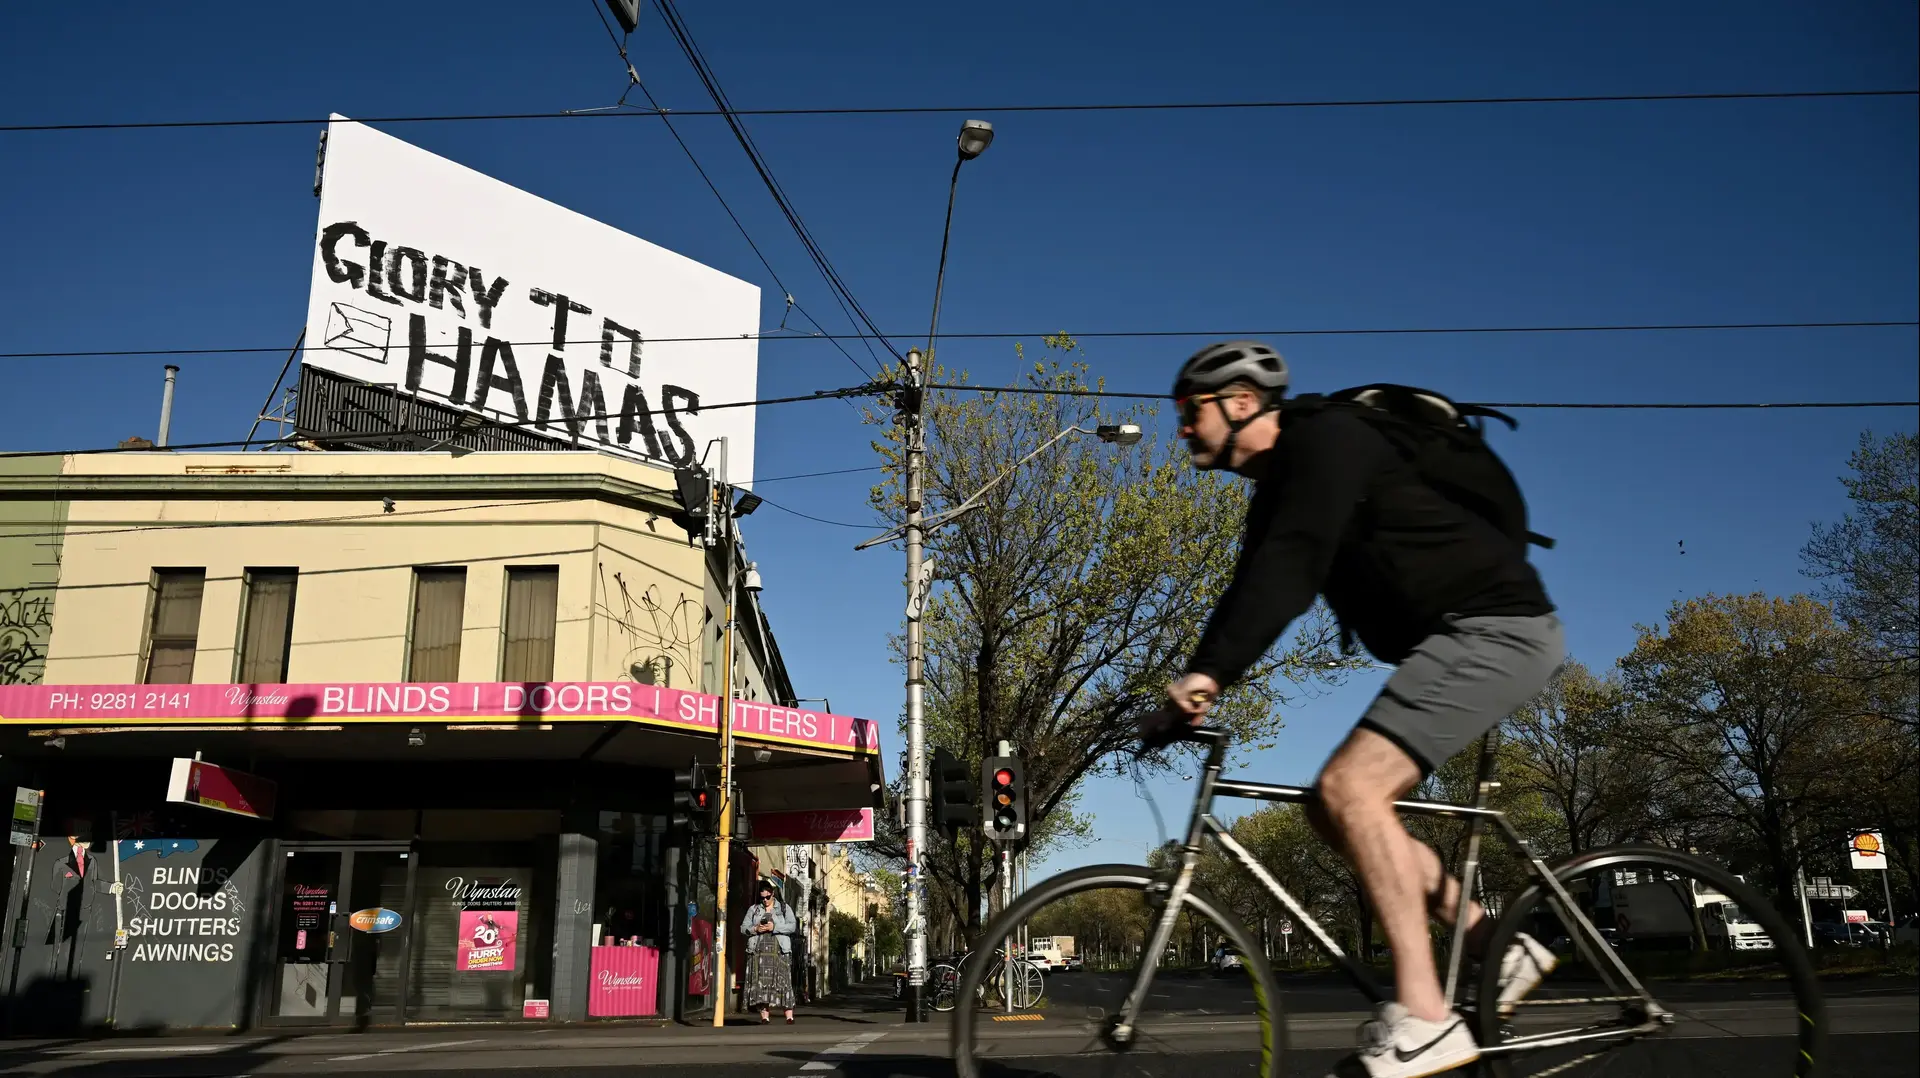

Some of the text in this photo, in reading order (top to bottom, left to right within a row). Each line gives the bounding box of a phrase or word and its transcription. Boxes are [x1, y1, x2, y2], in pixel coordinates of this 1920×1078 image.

[320, 221, 644, 379] GLORY TO
[404, 313, 700, 469] HAMAS
[49, 692, 191, 710] PH: 9281 2141
[224, 686, 289, 715] Wynstan
[322, 685, 451, 714] BLINDS
[503, 685, 632, 713] DOORS
[152, 867, 229, 885] BLINDS
[445, 876, 522, 904] Wynstan
[150, 892, 227, 910] DOORS
[129, 918, 241, 936] SHUTTERS
[356, 915, 395, 925] crimsafe
[132, 943, 234, 962] AWNINGS
[468, 948, 504, 960] HURRY
[468, 956, 488, 964] ORDER
[598, 969, 643, 988] Wynstan
